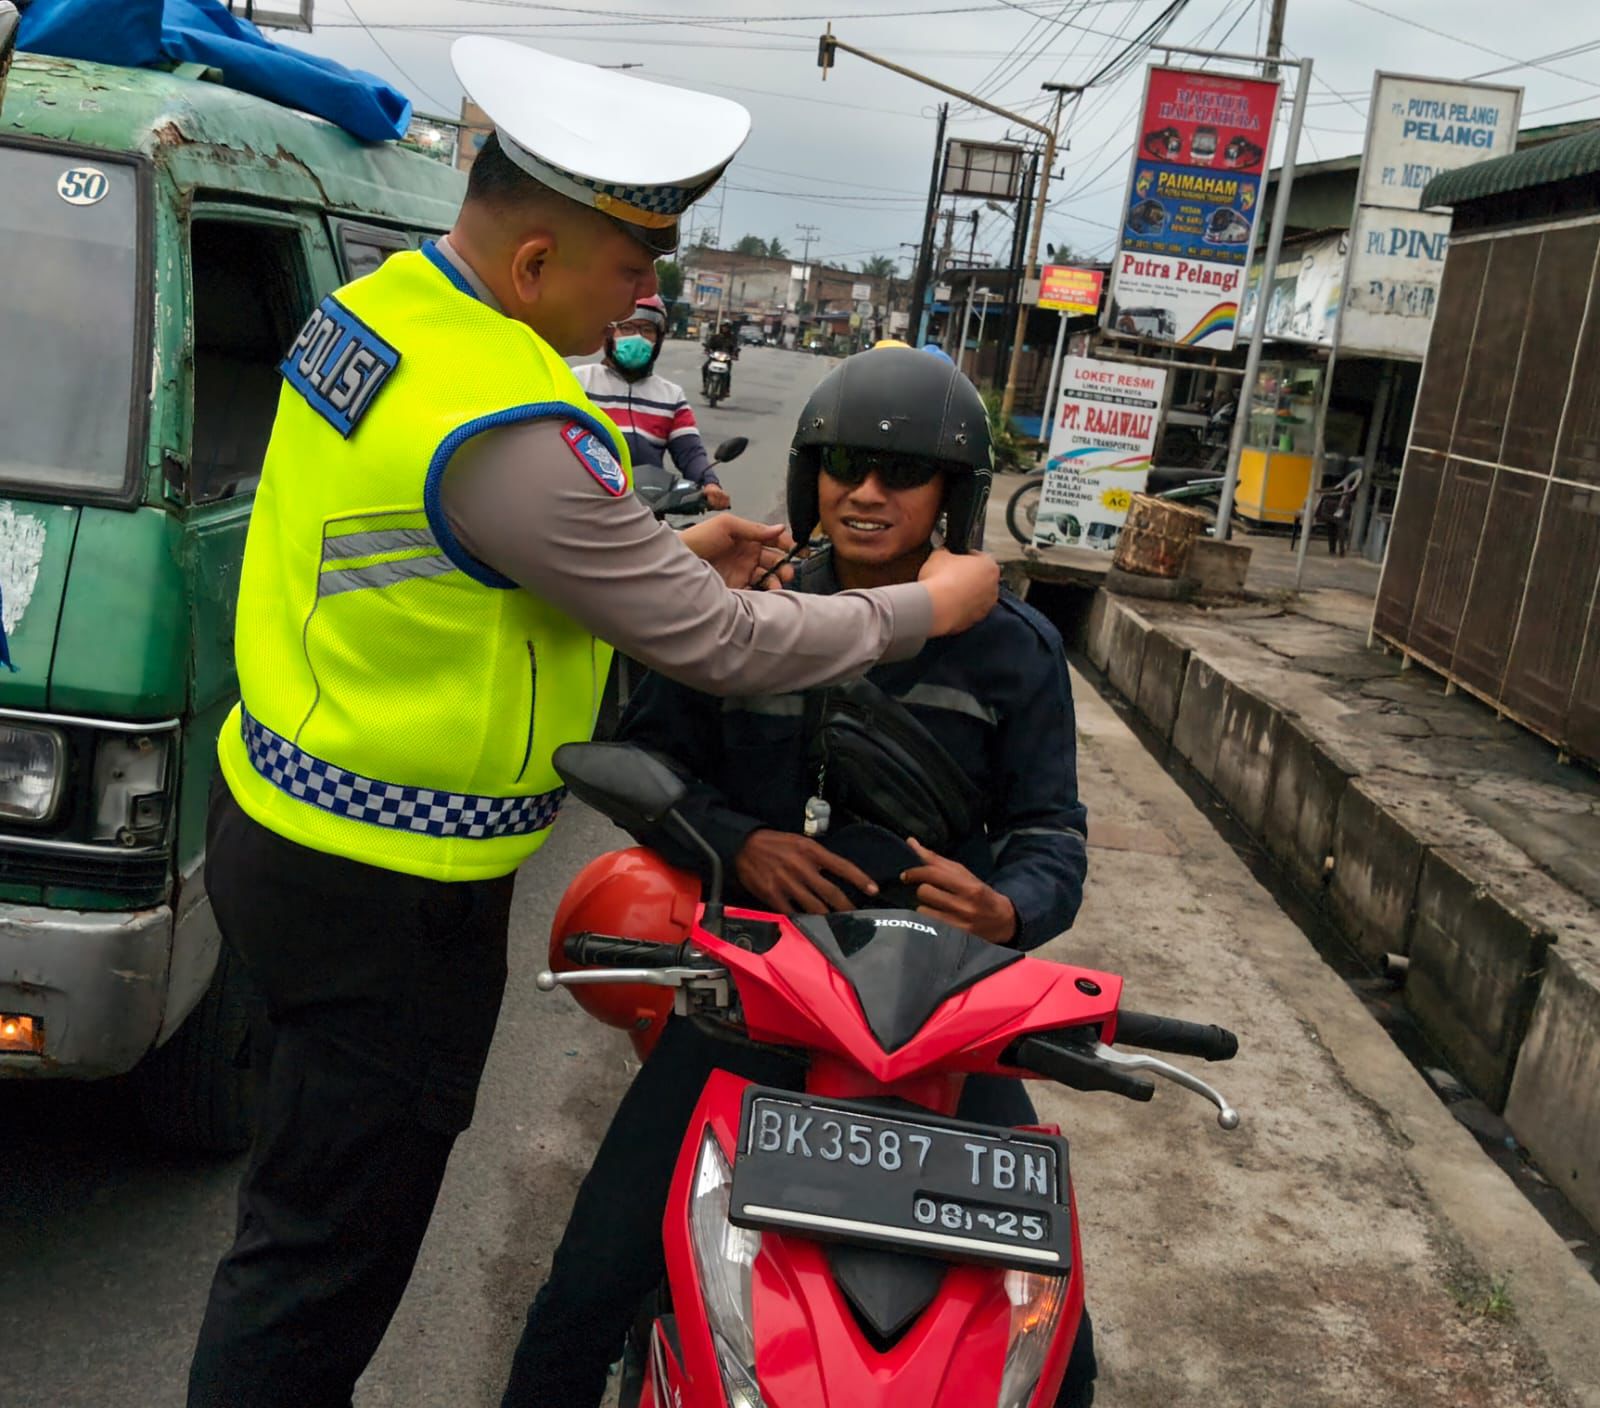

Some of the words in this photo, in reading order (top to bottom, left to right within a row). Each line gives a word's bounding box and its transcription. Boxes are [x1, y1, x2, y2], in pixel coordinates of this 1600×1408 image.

[1408, 98, 1446, 120] PUTRA
[1448, 103, 1499, 127] PELANGI
[1403, 119, 1494, 149] PELANGI
[61, 170, 107, 199] 50
[1158, 171, 1238, 195] PAIMAHAM
[1401, 163, 1452, 189] MED
[1121, 254, 1171, 279] Putra
[1175, 261, 1240, 292] Pelangi
[287, 308, 387, 419] POLISI
[1074, 368, 1115, 384] LOKET
[1117, 374, 1155, 390] RESMI
[1060, 403, 1081, 430] PT.
[1084, 407, 1153, 440] RAJAWALI
[1071, 435, 1091, 446] CITRA
[1093, 438, 1140, 452] TRANSPORTASI
[1049, 473, 1069, 481] LIMA
[1071, 476, 1100, 486] PULUH
[1056, 466, 1080, 475] EDAN
[1046, 489, 1093, 501] PERAWANG
[1056, 482, 1082, 491] BALAI
[1045, 497, 1079, 507] KERINCI
[1108, 497, 1127, 507] AC
[873, 919, 938, 937] HONDA
[964, 1142, 1048, 1195] TBN
